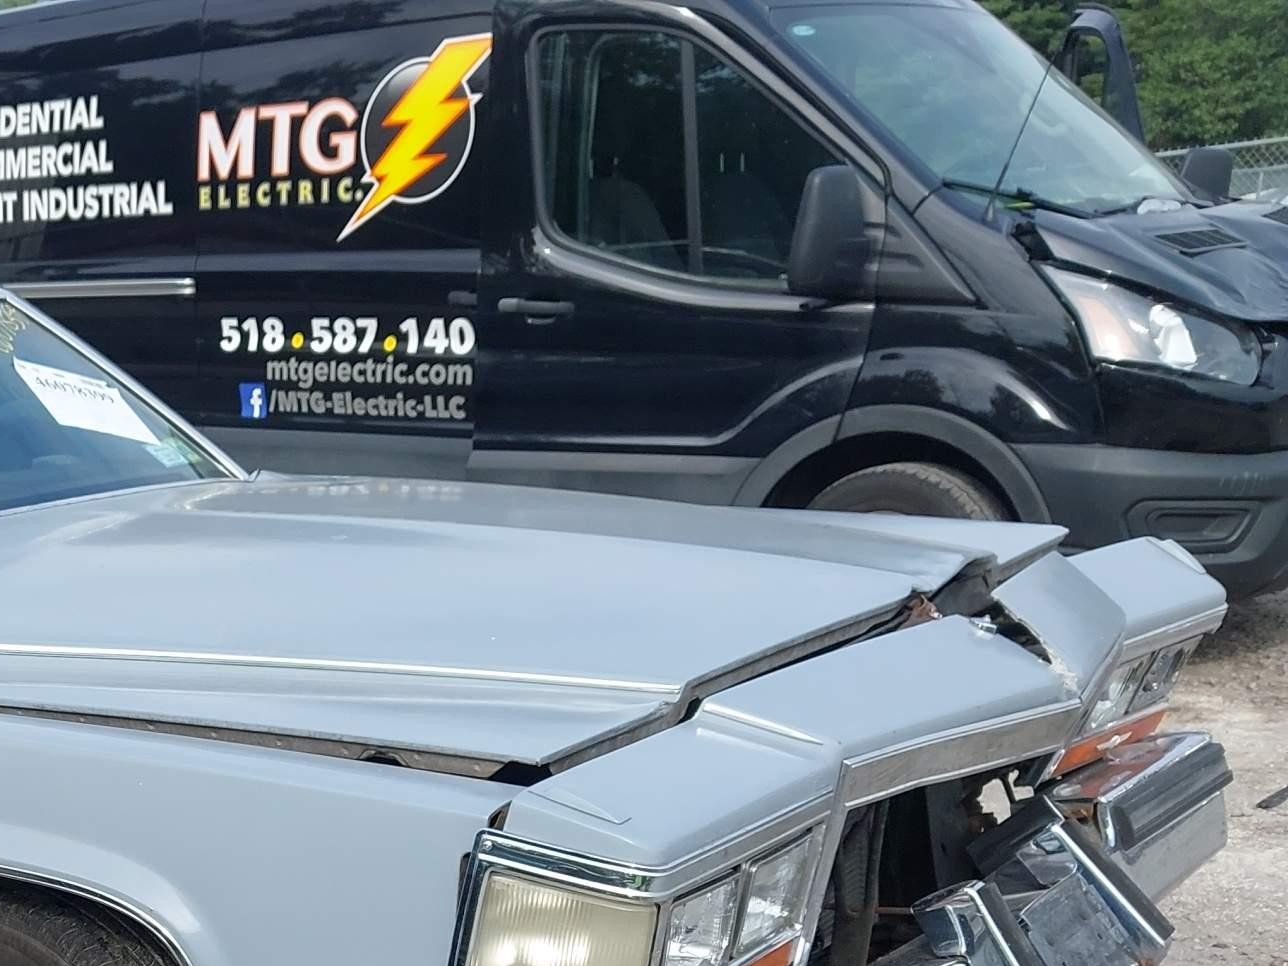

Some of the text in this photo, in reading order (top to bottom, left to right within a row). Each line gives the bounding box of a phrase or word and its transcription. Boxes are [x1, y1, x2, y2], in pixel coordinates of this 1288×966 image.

[197, 97, 359, 182] MTG
[22, 181, 174, 222] INDUSTRIAL
[266, 355, 473, 388] mtgelectric.com
